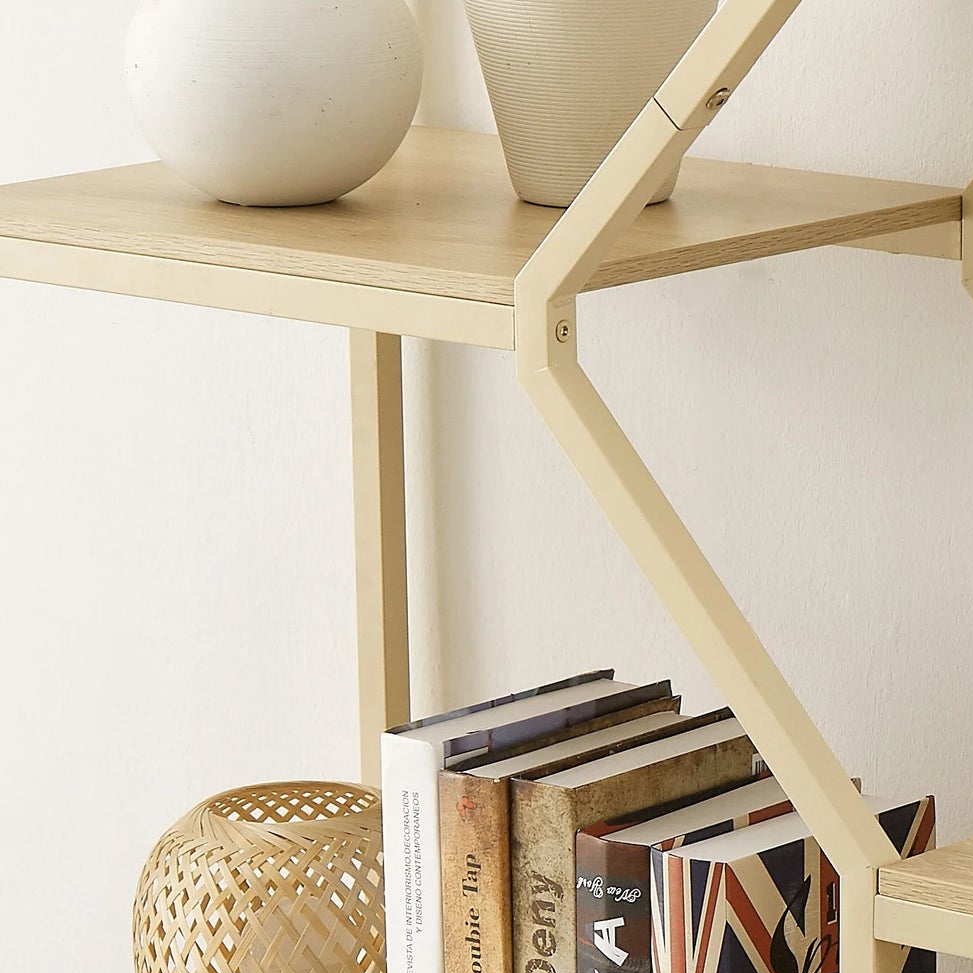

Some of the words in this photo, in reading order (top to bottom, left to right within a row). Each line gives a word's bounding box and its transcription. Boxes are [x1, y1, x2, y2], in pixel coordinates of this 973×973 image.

[412, 792, 422, 887] CONTEMPORANEOS
[462, 853, 482, 898] Tap
[406, 928, 413, 942] DE
